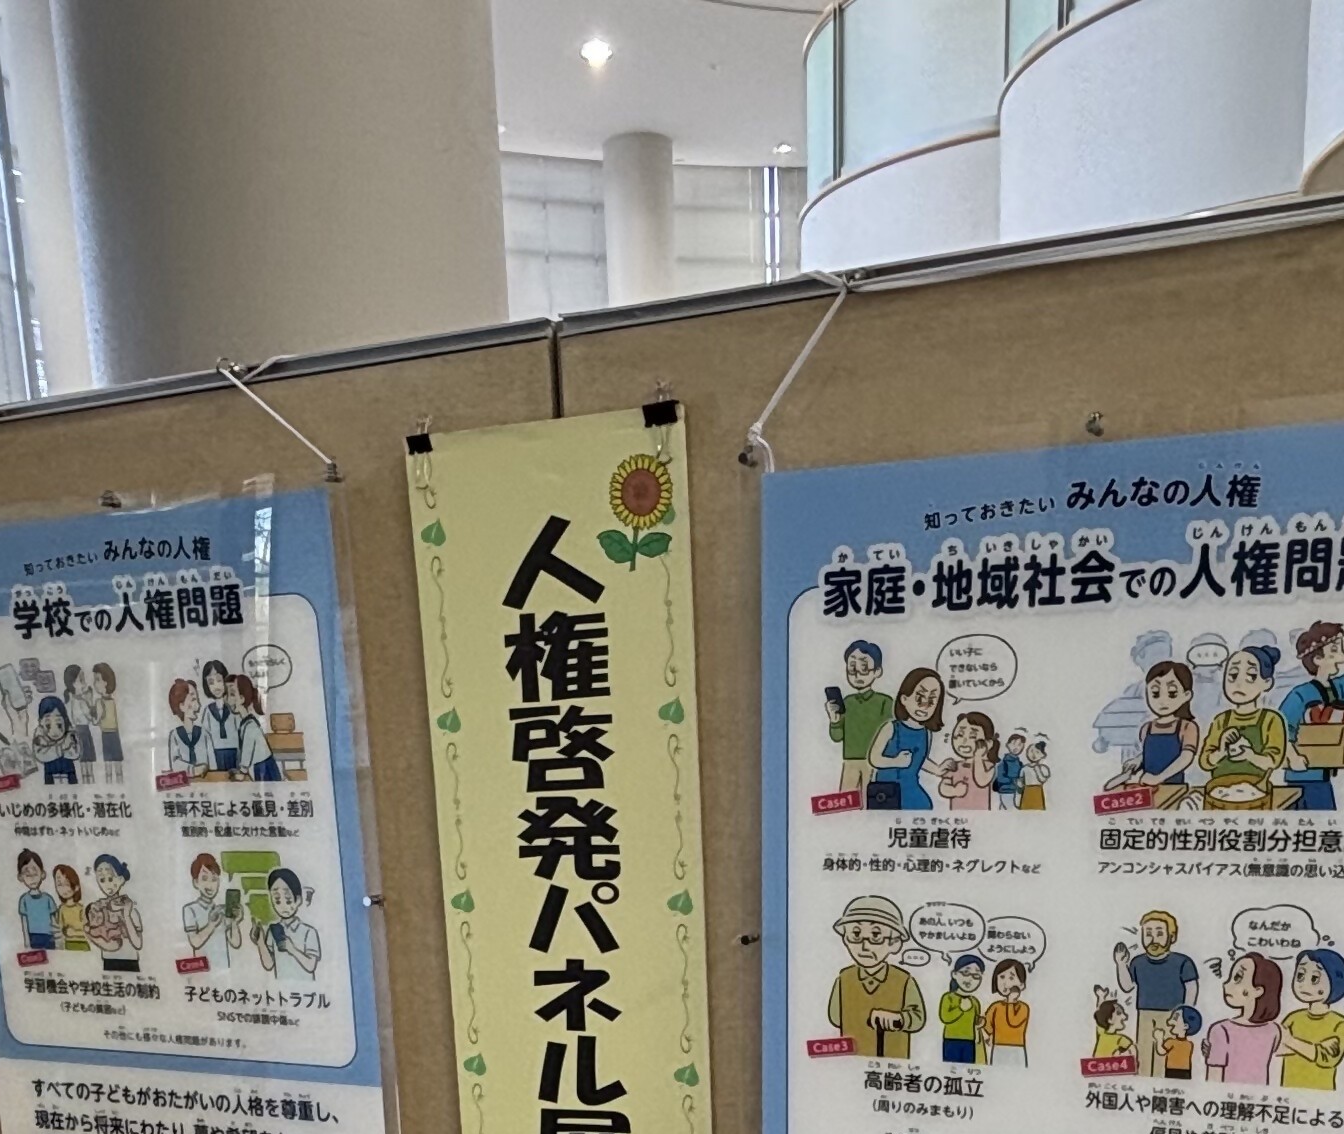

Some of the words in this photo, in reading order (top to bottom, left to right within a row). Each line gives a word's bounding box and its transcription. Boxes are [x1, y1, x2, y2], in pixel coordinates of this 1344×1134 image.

[924, 497, 1055, 531] 知っておきたい
[1066, 473, 1262, 510] みんなの人権
[24, 552, 97, 576] 知っておきたい
[104, 536, 210, 560] みんなの人権
[13, 583, 244, 640] 学校での人権問題
[163, 800, 313, 819] 理解不足による偏見・差別
[817, 797, 854, 810] Case1
[1100, 793, 1144, 809] Case2
[887, 827, 971, 849] 児童虐待
[823, 858, 1041, 874] 身体的・性的・心理的・ネグレクトなど
[1248, 920, 1291, 931] なんだか
[987, 944, 1036, 954] ようにしよう
[1247, 937, 1301, 948] こわいわね
[184, 986, 331, 1009] 子どものネットトラブル
[813, 1041, 849, 1053] Case3
[1087, 1060, 1128, 1072] Case4
[864, 1070, 984, 1098] 高齢者の孤立
[32, 1078, 339, 1124] すべての子どもがおたがいの人格を尊重し、
[1086, 1091, 1344, 1129] 外国人や障害への理解不足による
